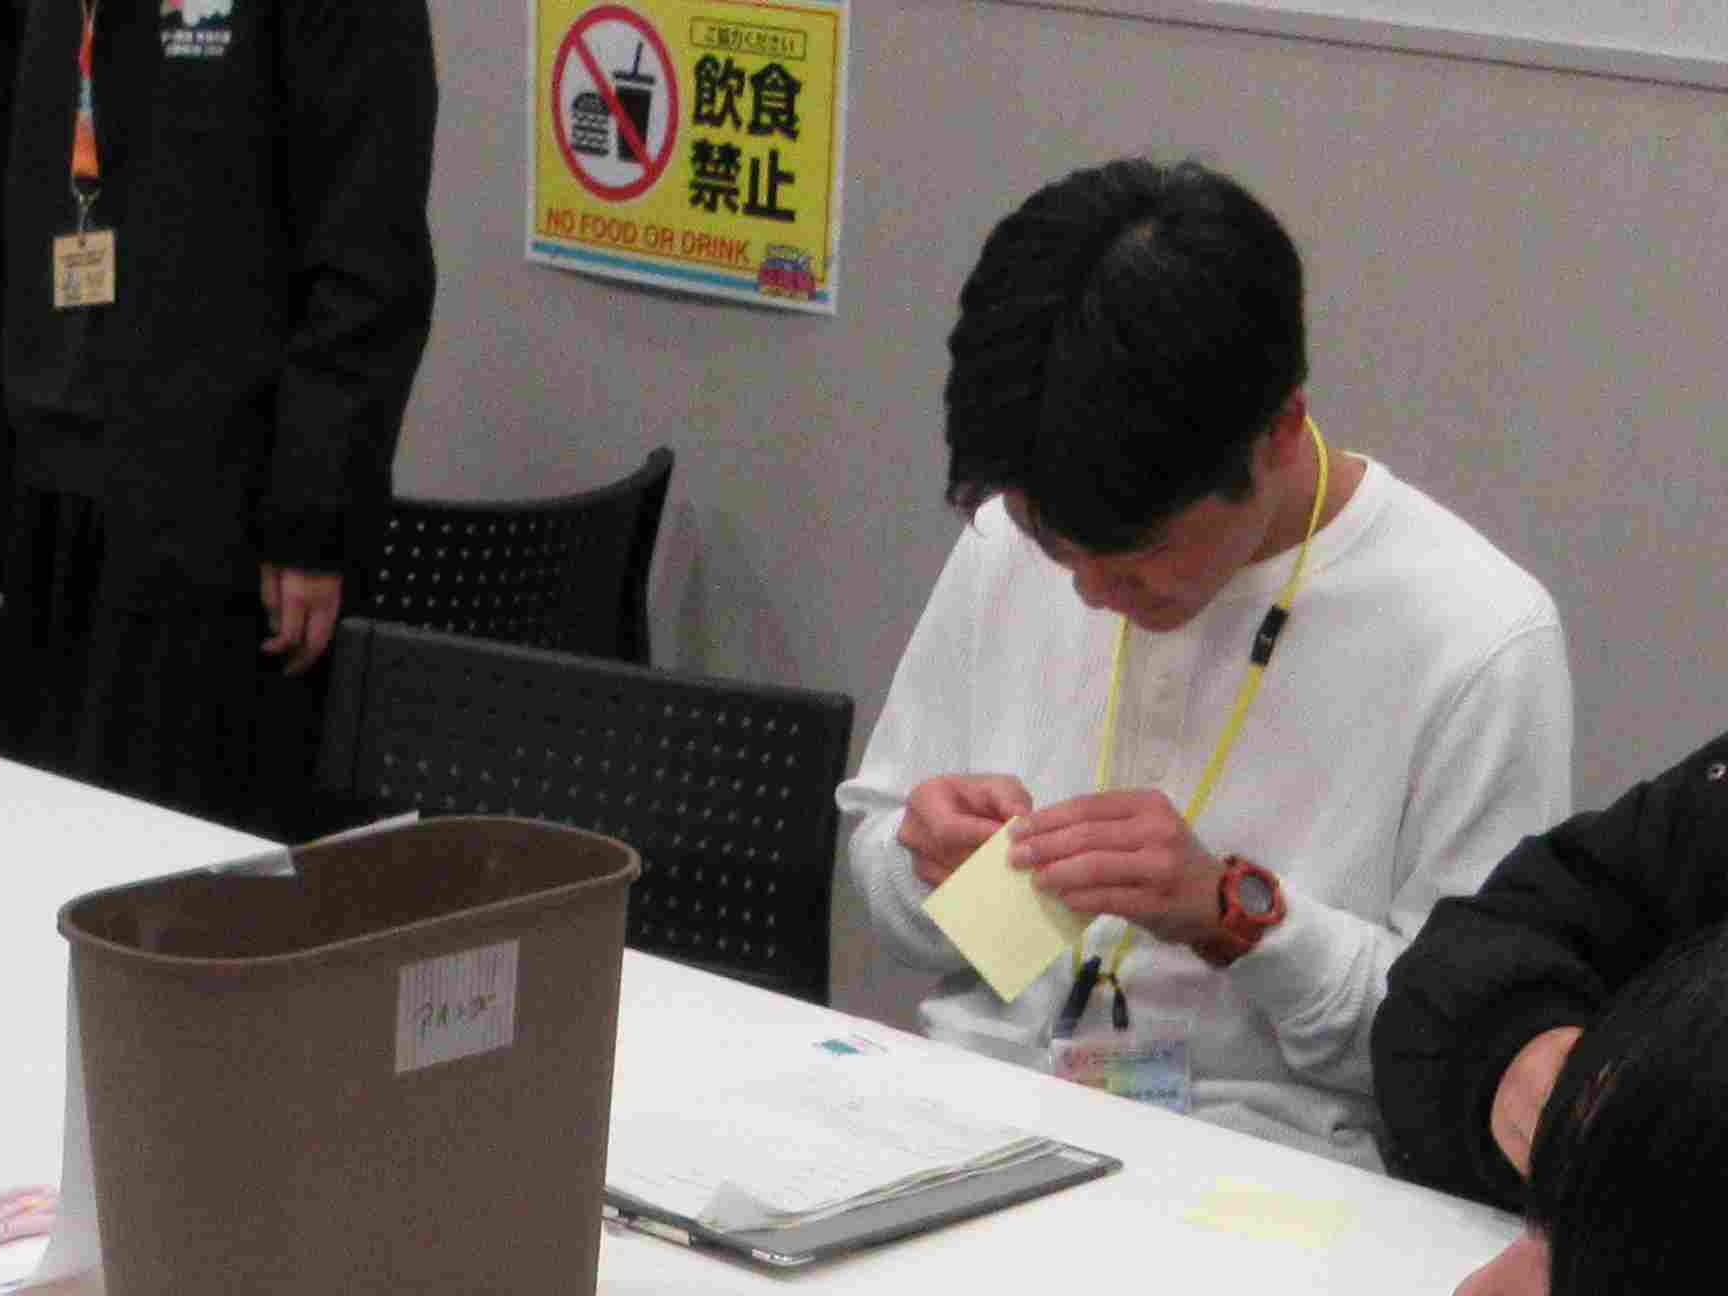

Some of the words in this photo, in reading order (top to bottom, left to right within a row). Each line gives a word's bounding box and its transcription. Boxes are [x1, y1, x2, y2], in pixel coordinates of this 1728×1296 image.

[694, 55, 801, 141] 飲食
[689, 139, 796, 223] 禁止
[546, 207, 575, 234] NO
[580, 213, 638, 246] FOOD
[646, 222, 677, 252] OR
[680, 228, 751, 266] DRINK
